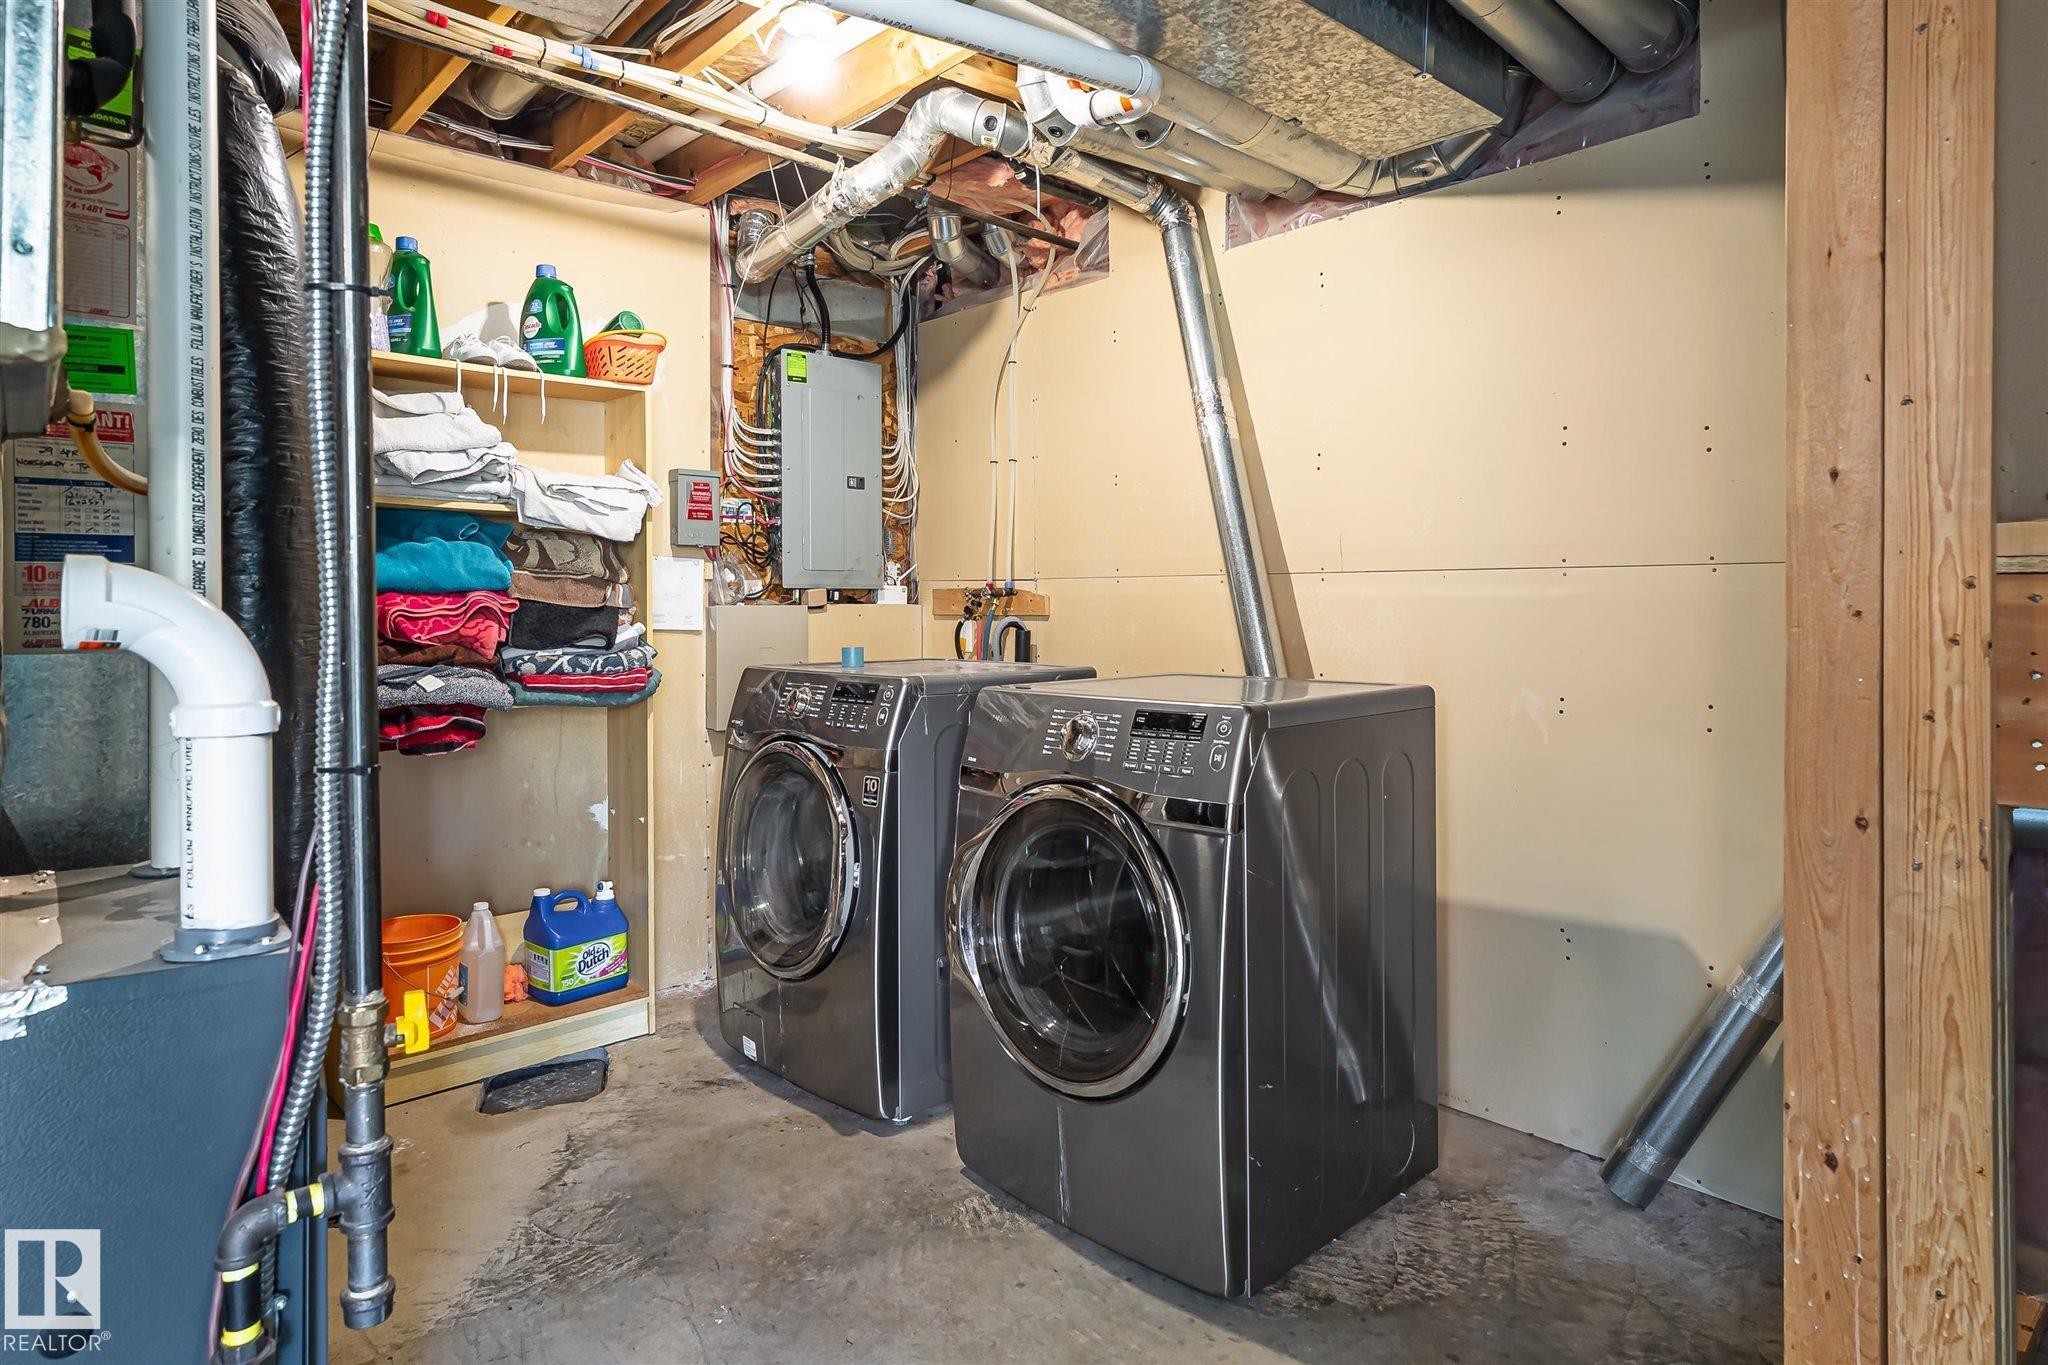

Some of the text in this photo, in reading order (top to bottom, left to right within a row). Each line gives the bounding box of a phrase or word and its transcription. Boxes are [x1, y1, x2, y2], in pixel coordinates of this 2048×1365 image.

[186, 42, 200, 52] DU
[187, 53, 201, 106] INSTRUCTIONS
[188, 107, 202, 122] LES
[189, 207, 203, 258] INSTALLATION
[190, 324, 204, 350] FOLLOW
[190, 356, 205, 408] COMBUSTIBLES
[192, 410, 205, 425] DES
[192, 426, 205, 445] ZERO
[192, 547, 206, 556] TO
[192, 560, 206, 598] LEARANCE
[22, 616, 61, 628] 780-
[866, 778, 878, 792] 10
[577, 948, 610, 973] Dutch
[582, 946, 596, 960] Old
[562, 978, 574, 988] 150
